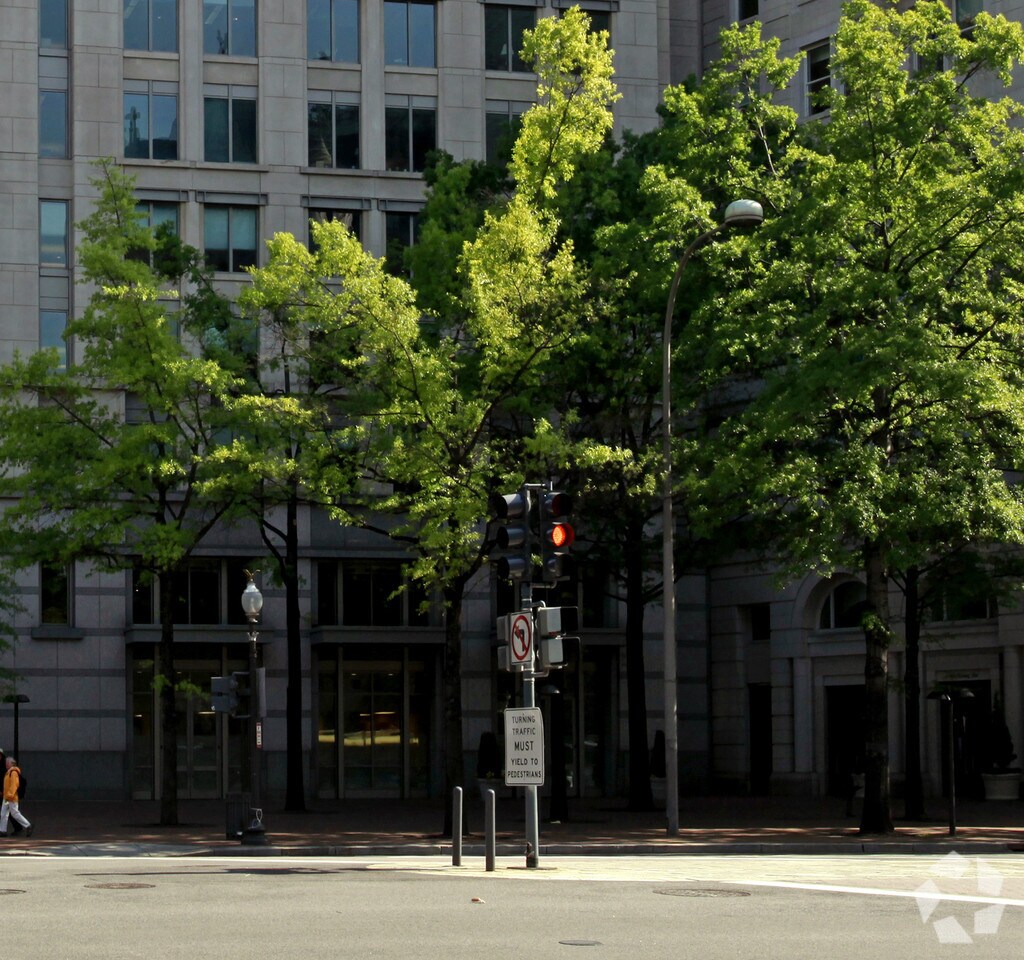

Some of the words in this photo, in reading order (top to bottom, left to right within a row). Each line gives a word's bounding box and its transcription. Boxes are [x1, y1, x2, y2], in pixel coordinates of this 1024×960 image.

[512, 727, 536, 735] TRAFFIC
[514, 741, 534, 751] MUST
[511, 758, 528, 766] YIELD
[531, 758, 539, 766] TO
[508, 770, 542, 778] PEDESTRIANS
